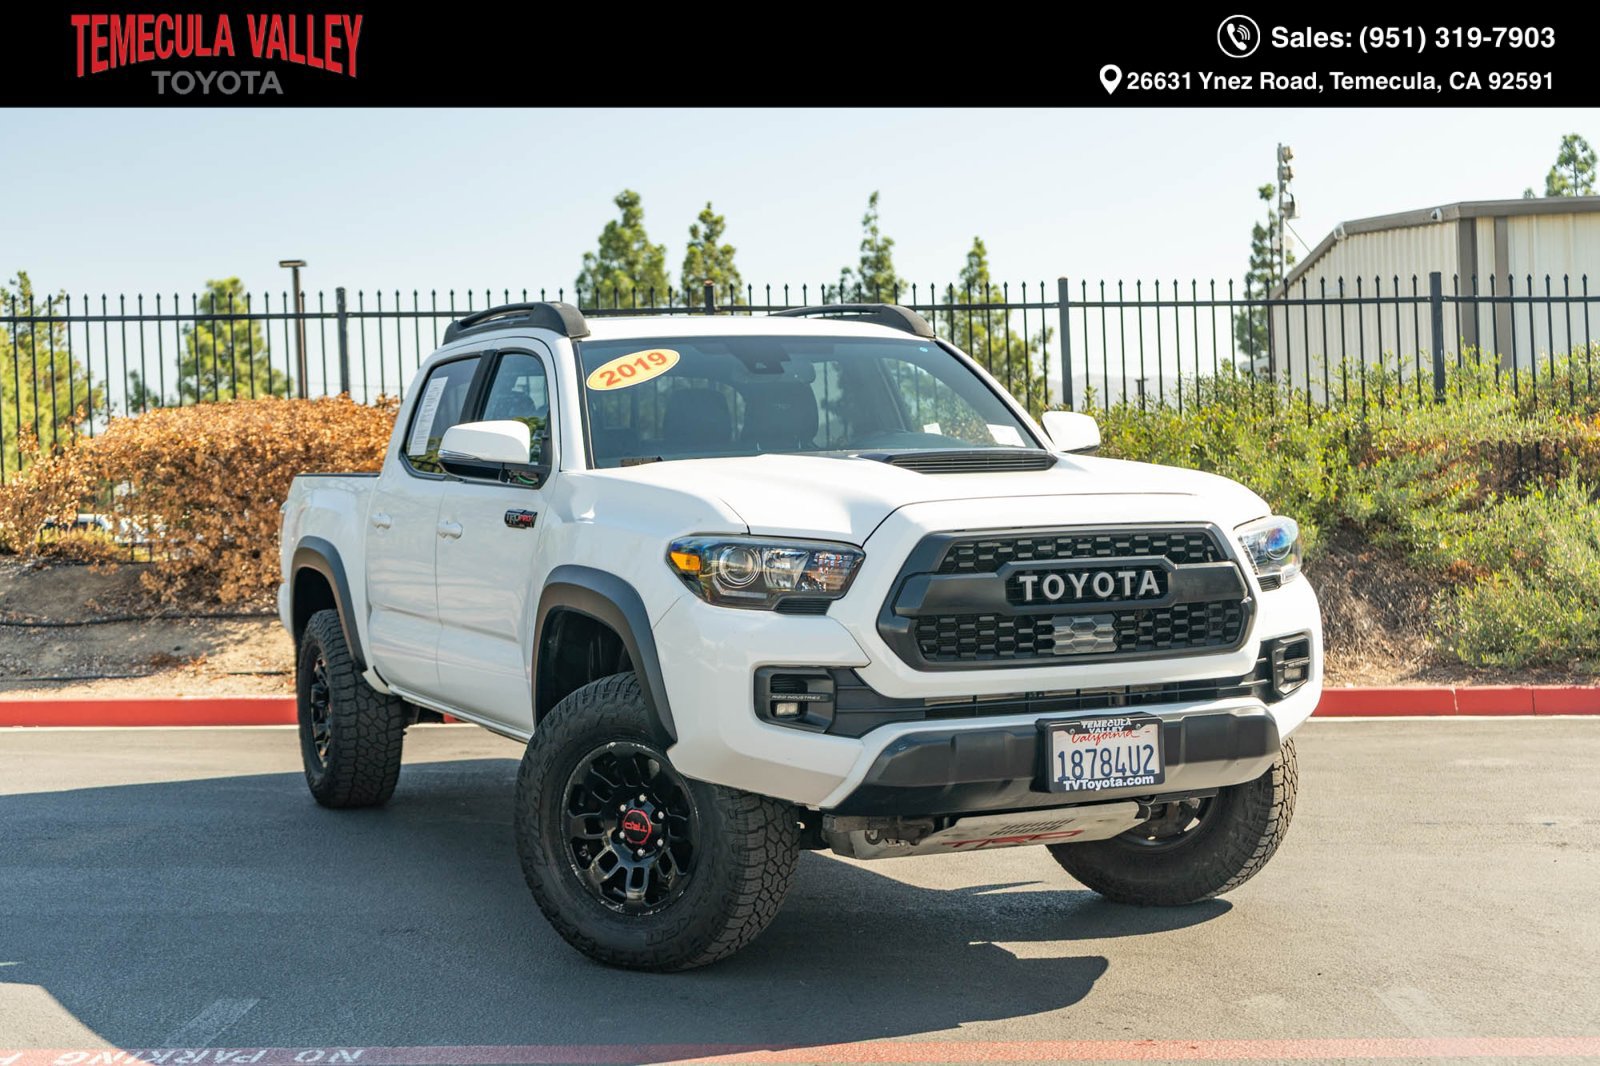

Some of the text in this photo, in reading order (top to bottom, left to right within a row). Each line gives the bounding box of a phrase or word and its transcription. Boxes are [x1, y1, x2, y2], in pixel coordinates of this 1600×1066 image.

[599, 352, 667, 387] 2019
[1018, 570, 1160, 601] TOYOTA
[1080, 717, 1132, 729] TEMECULA
[1088, 725, 1125, 734] VALLEY
[1071, 729, 1140, 746] California
[1057, 744, 1156, 782] 18784U2
[1063, 775, 1155, 792] TVToyota.com
[623, 821, 648, 833] TRD
[942, 829, 1085, 848] TRD
[53, 1049, 364, 1066] NO PARKING
